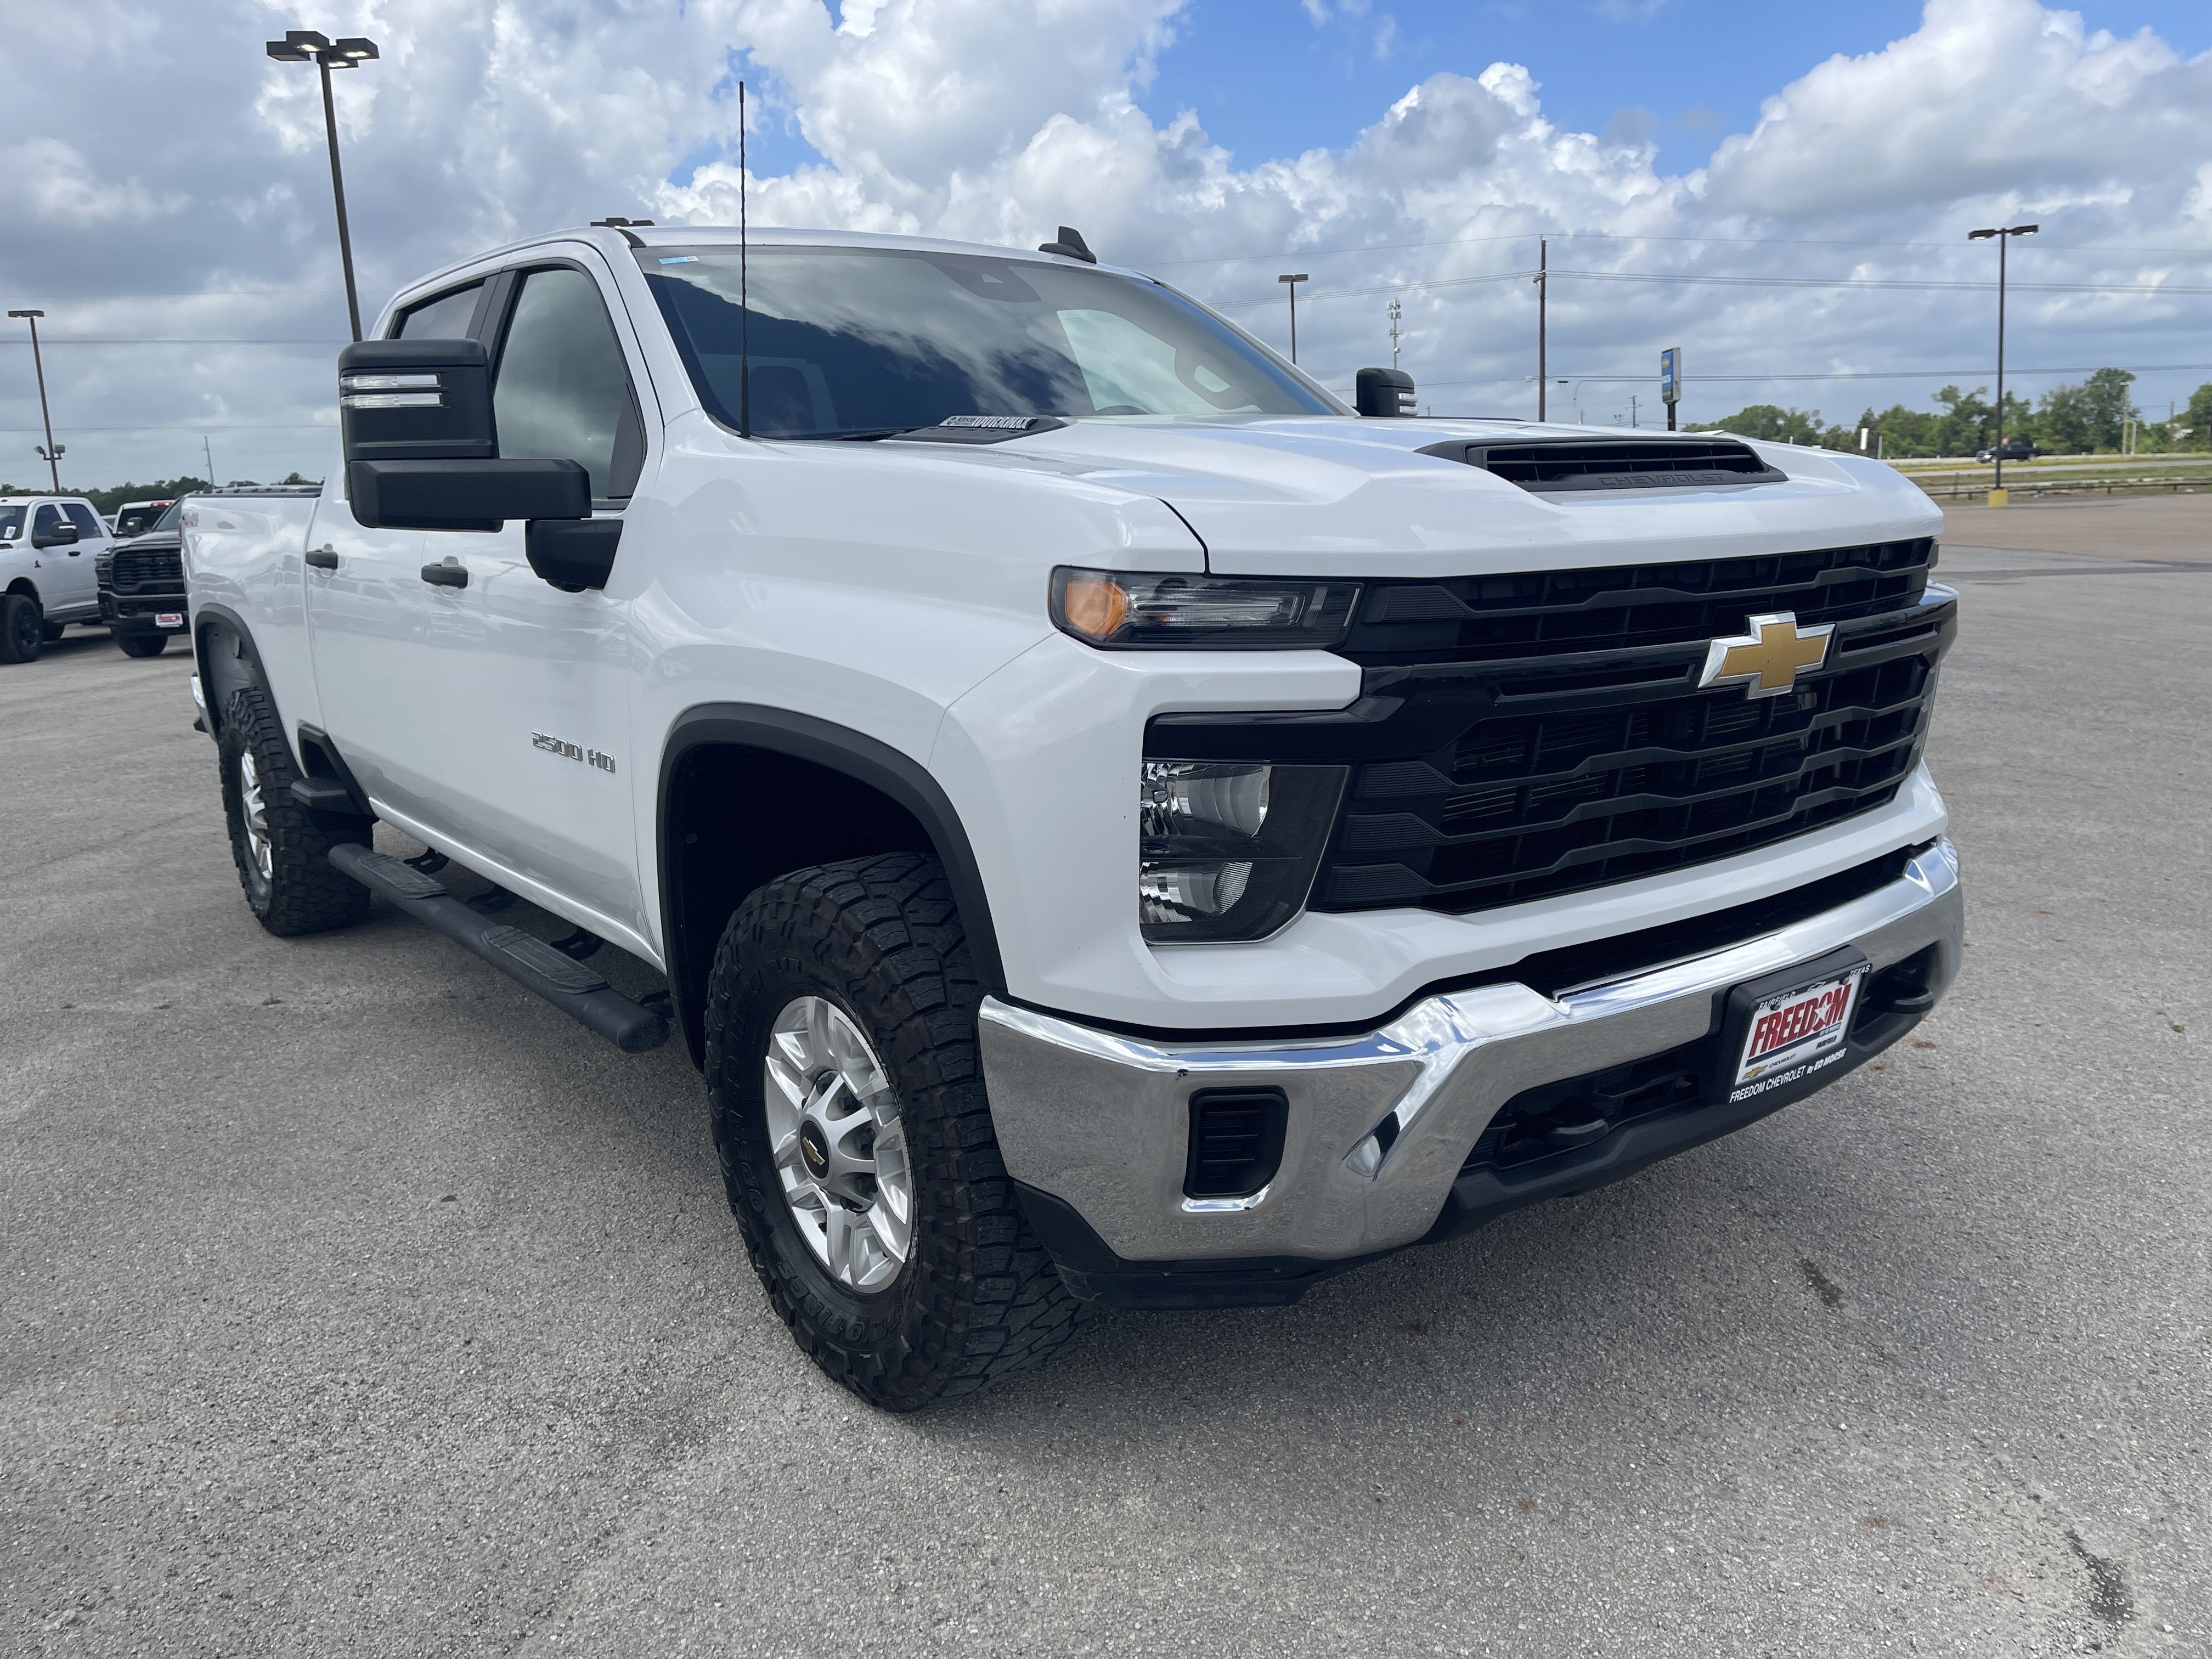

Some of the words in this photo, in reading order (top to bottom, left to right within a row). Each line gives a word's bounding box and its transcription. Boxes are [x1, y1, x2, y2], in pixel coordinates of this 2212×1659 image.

[972, 416, 1036, 430] DURAMAX
[1597, 473, 1724, 486] CHEVROLET
[531, 730, 583, 761] 2500
[587, 748, 616, 774] HD
[1849, 964, 1871, 978] TEXAS
[1759, 991, 1796, 1011] FAIRFIELD
[1748, 983, 1853, 1058] FREEDOM
[1769, 1053, 1797, 1069] CHEVROLET
[1729, 1080, 1766, 1104] FREEDOM
[1765, 1065, 1807, 1091] CHEVROLET
[1813, 1059, 1824, 1071] ED
[1823, 1047, 1847, 1066] MORSE
